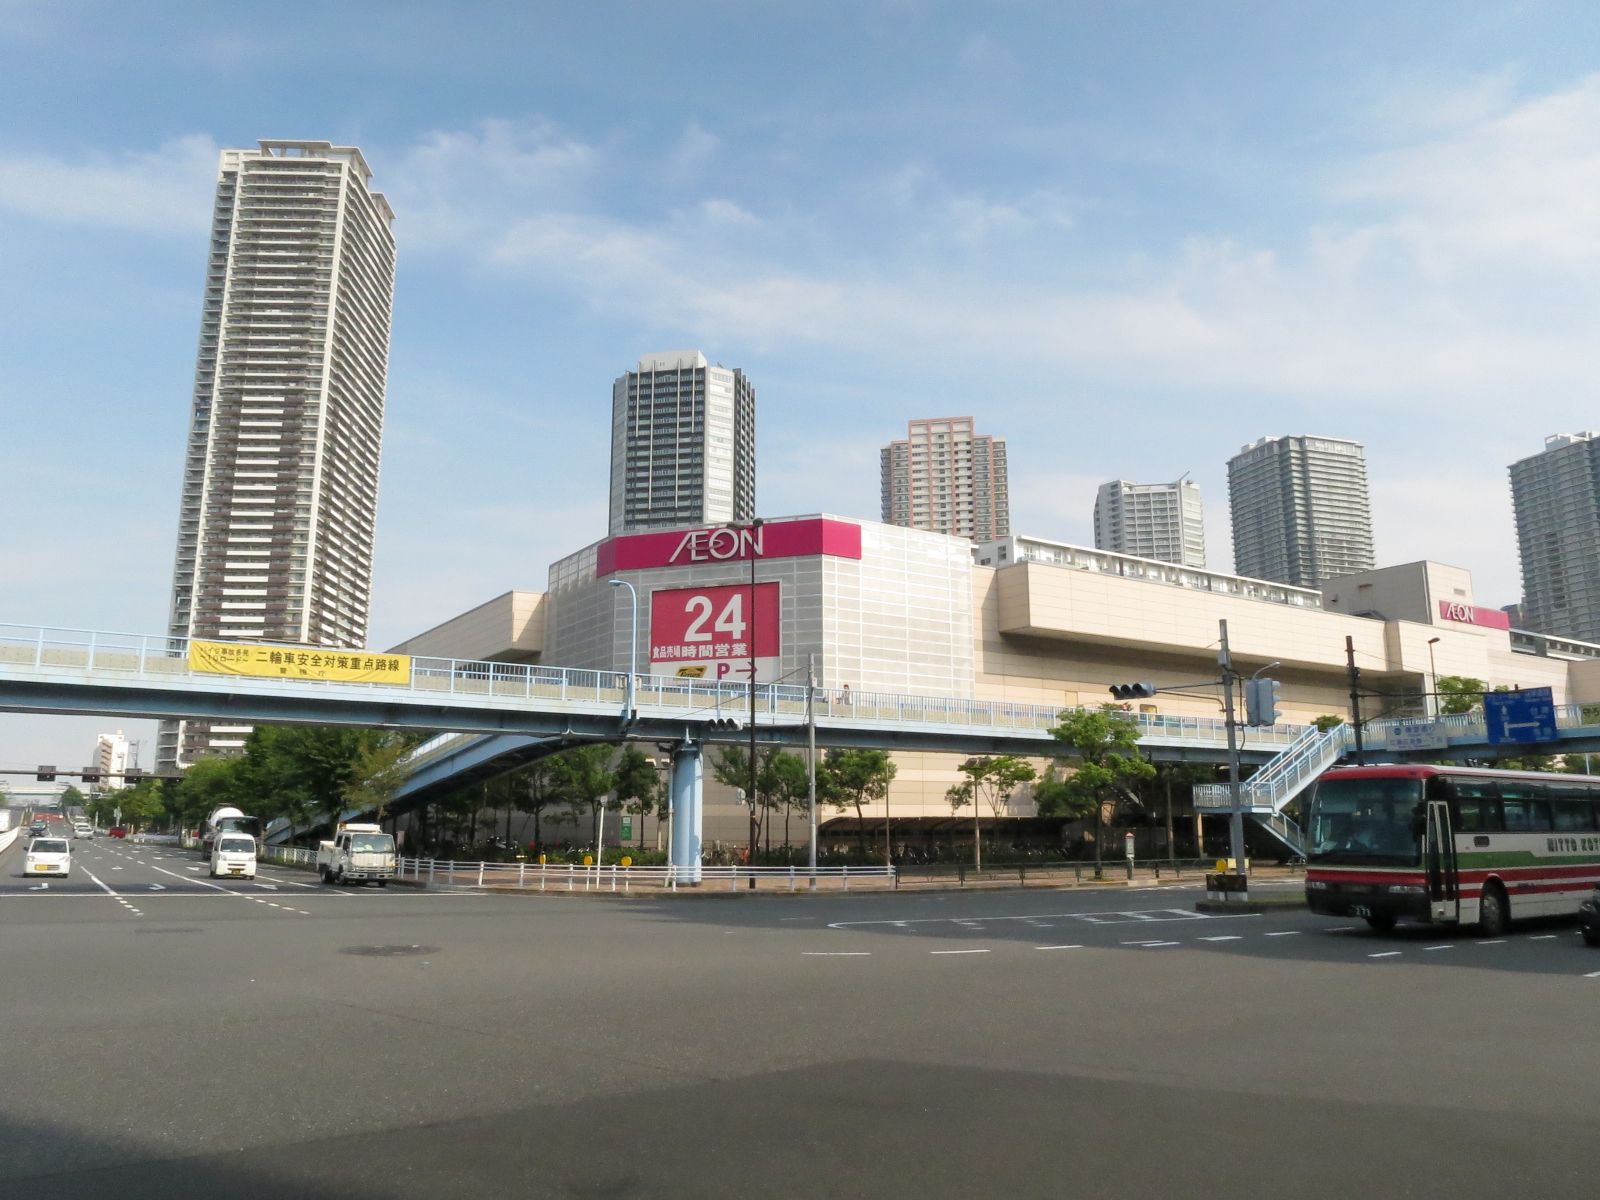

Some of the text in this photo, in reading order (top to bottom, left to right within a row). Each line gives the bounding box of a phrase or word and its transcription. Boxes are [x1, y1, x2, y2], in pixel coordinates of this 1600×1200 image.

[683, 593, 747, 643] 24
[255, 650, 400, 672] 二輪車安全対策重点路線
[716, 662, 731, 680] P
[1546, 837, 1578, 852] NITTO
